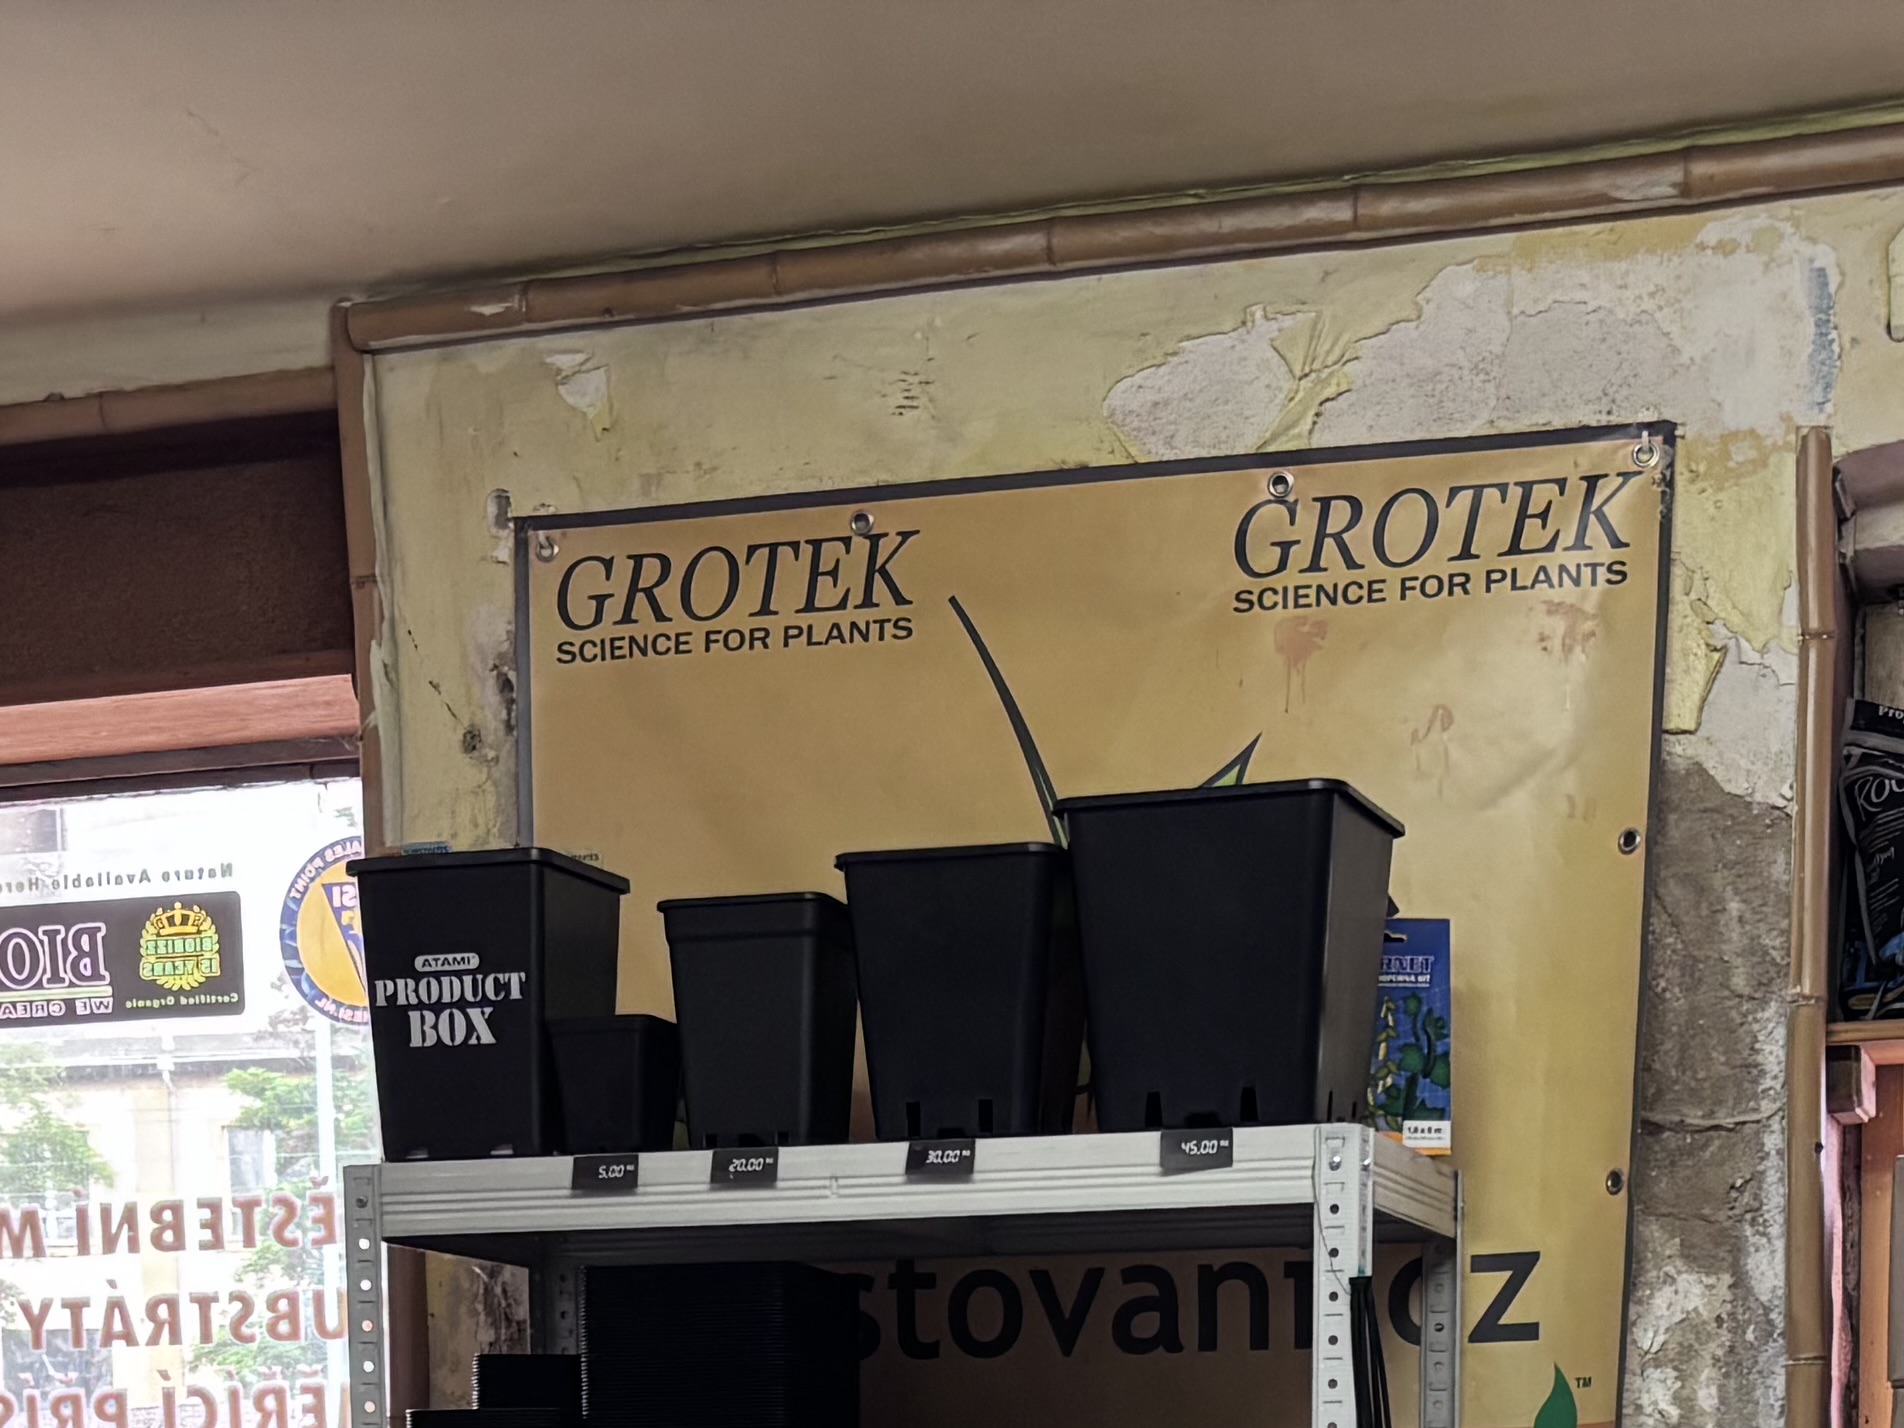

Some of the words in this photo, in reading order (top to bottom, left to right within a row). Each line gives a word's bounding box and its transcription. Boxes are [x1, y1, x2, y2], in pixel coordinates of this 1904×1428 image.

[1233, 470, 1645, 579] GROTEK
[556, 529, 920, 631] GROTEK
[1232, 578, 1387, 614] SCIENCE
[1399, 572, 1471, 602] FOR
[1485, 559, 1628, 595] PLANTS
[555, 631, 693, 664] SCIENCE
[703, 626, 771, 654] FOR
[782, 616, 914, 649] PLANTS
[420, 955, 472, 969] ATAMI
[374, 972, 526, 1007] PRODUCT
[407, 1006, 497, 1048] BOX
